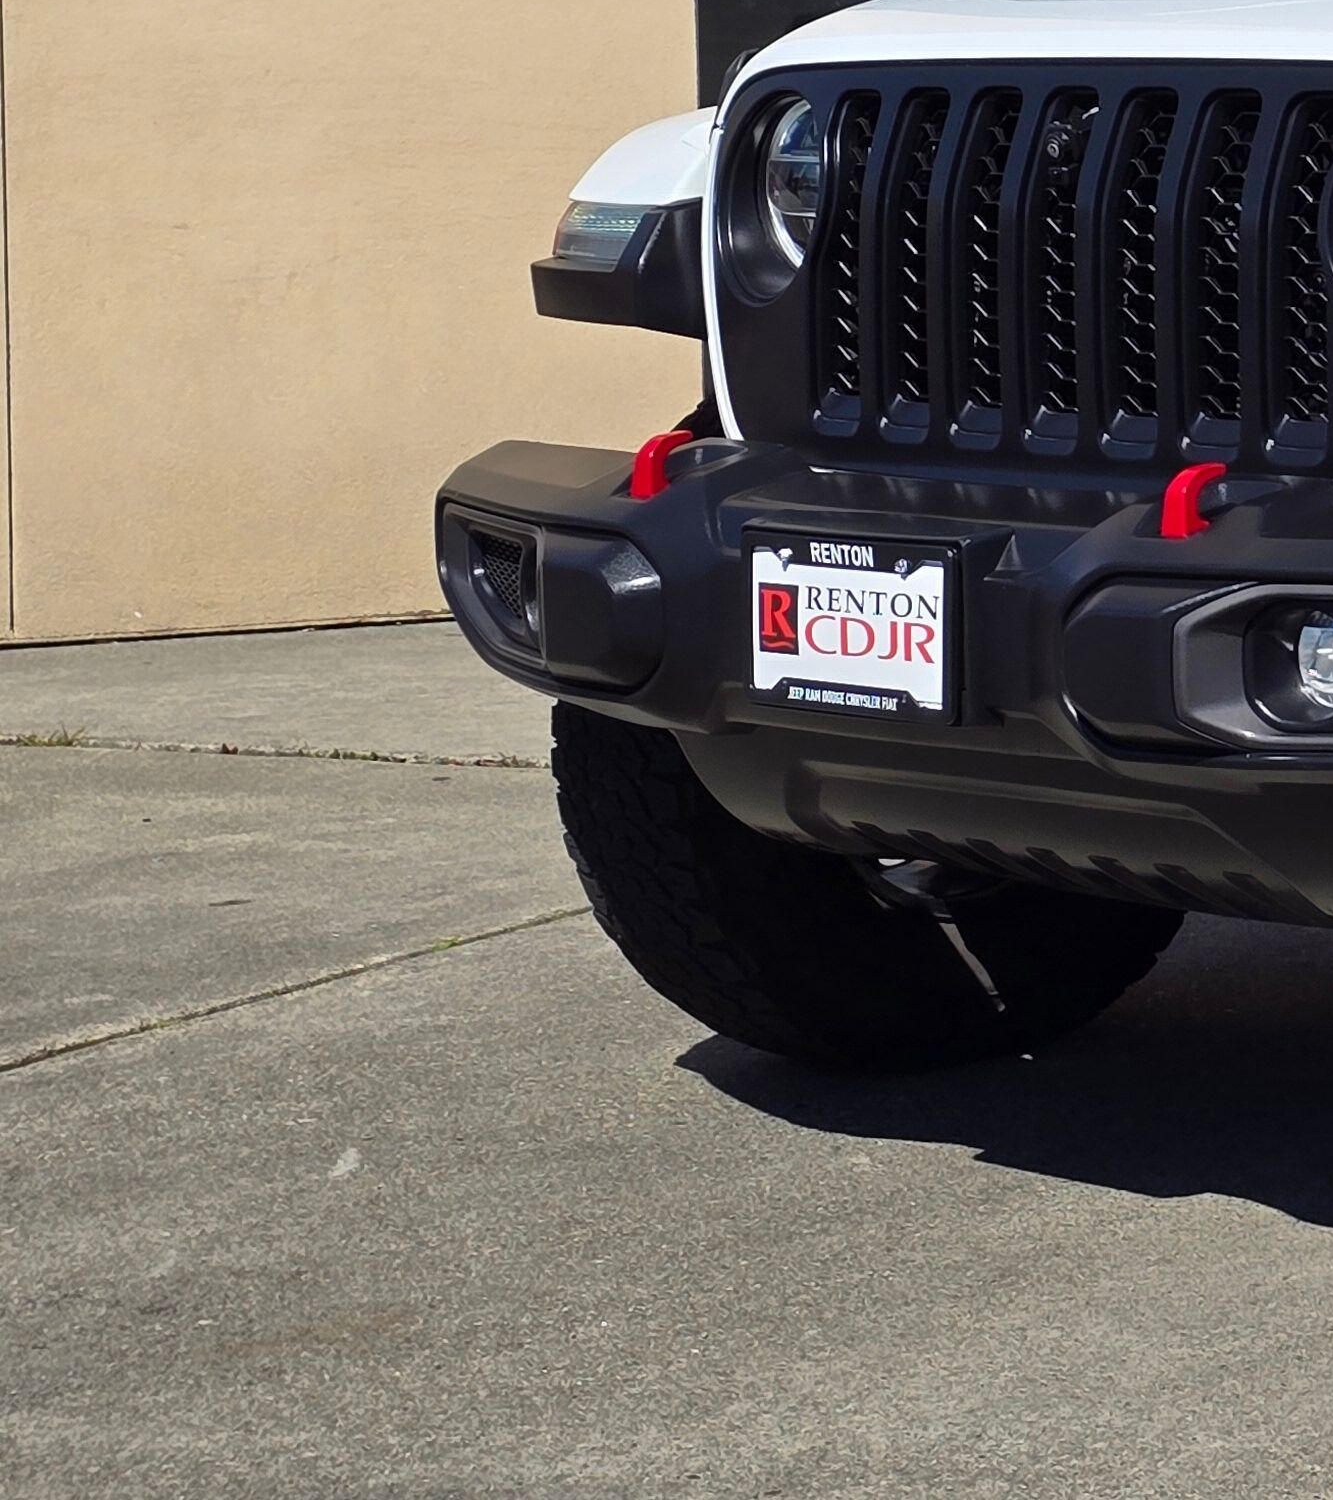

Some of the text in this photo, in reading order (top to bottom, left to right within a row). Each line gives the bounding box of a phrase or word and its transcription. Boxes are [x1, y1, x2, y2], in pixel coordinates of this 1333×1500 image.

[810, 542, 874, 568] RENTON
[760, 588, 796, 638] R
[805, 585, 940, 620] RENTON
[805, 615, 935, 664] CDJR
